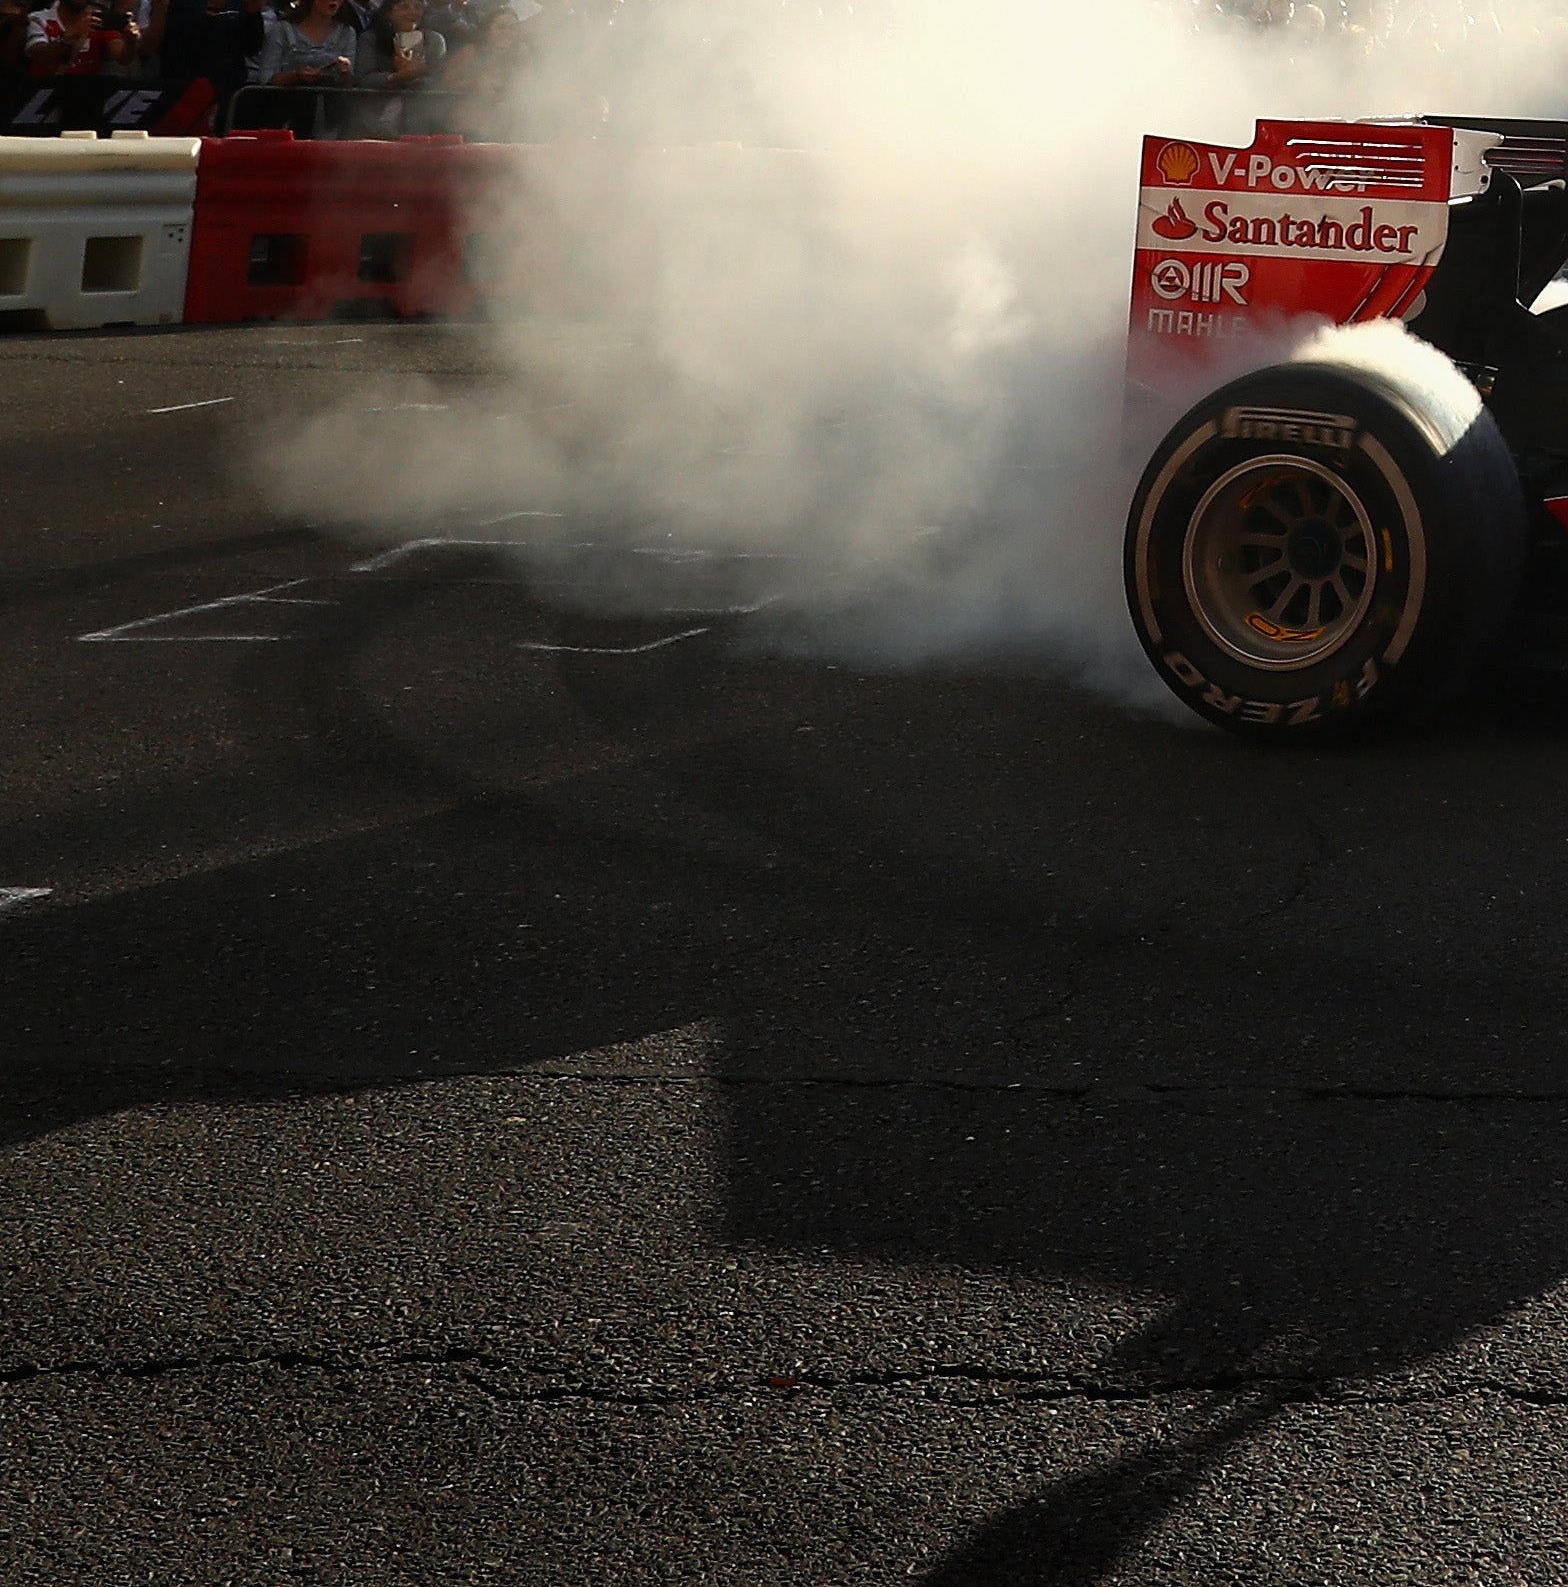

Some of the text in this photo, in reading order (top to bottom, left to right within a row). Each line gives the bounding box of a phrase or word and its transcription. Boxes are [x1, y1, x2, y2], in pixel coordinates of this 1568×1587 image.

[1208, 152, 1376, 192] V-Power
[1202, 201, 1418, 254] Santander
[1163, 652, 1324, 725] ZERO
